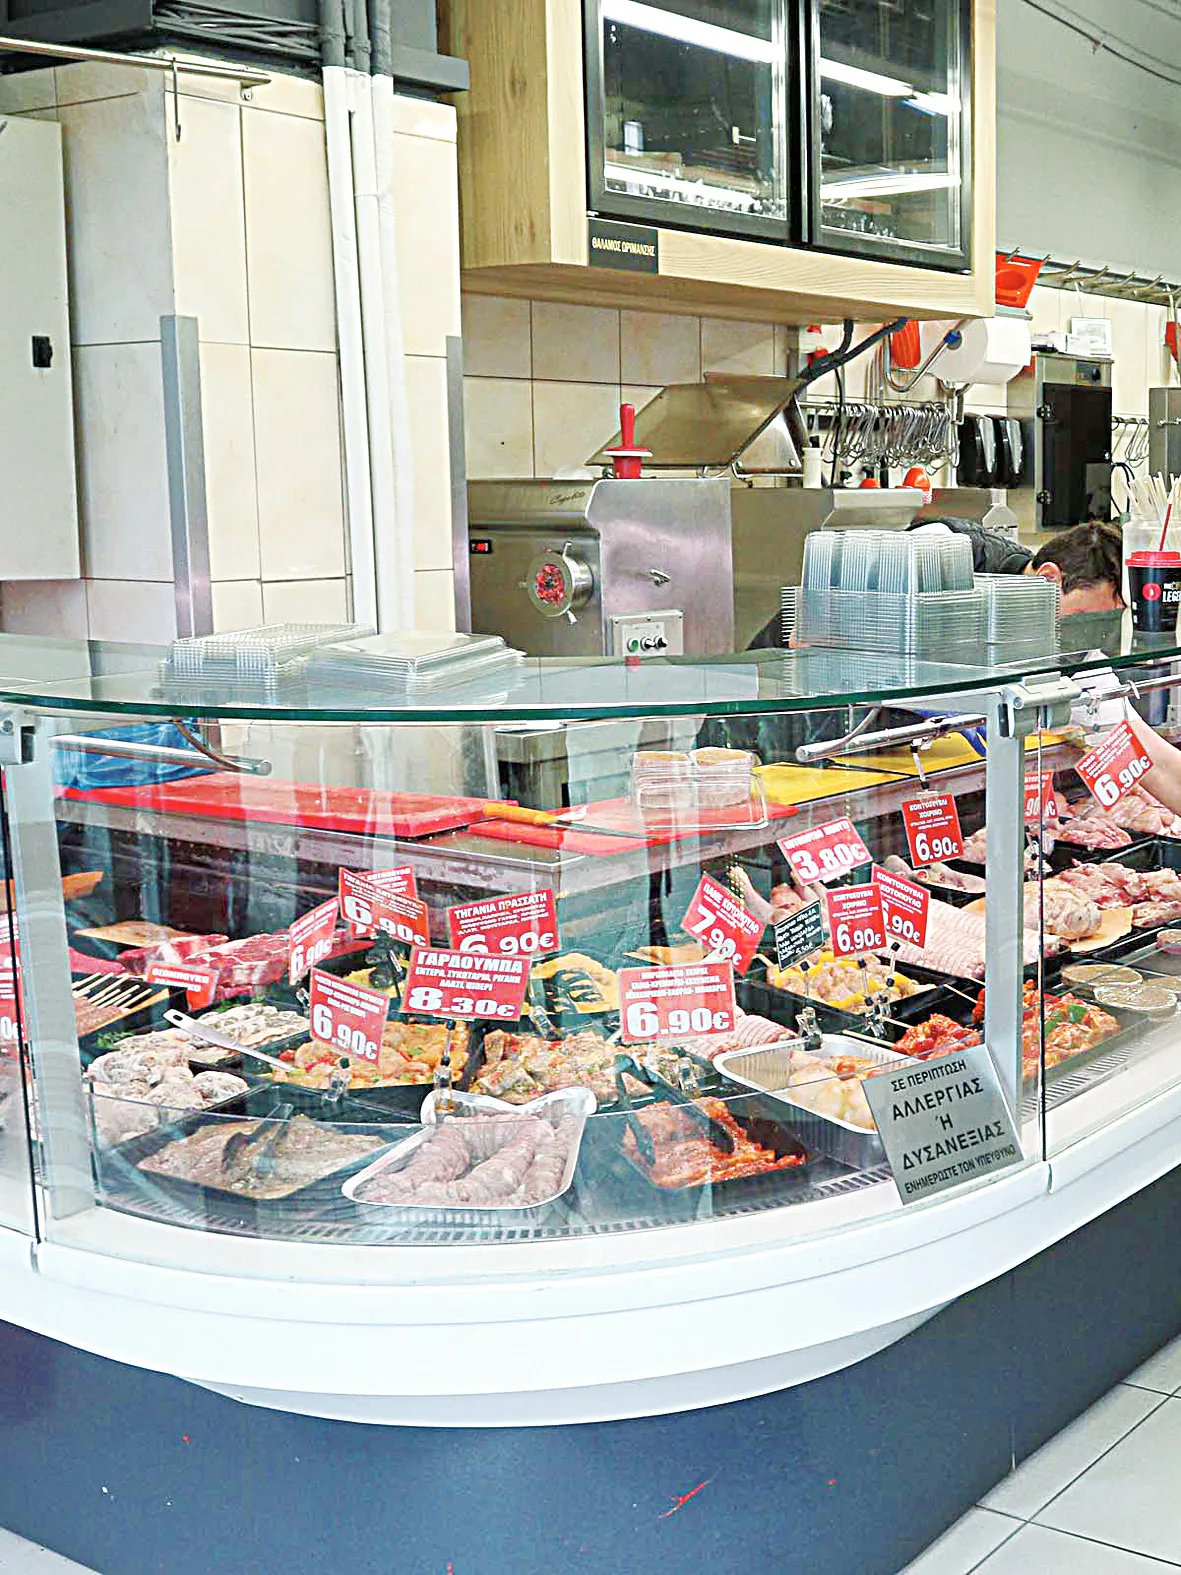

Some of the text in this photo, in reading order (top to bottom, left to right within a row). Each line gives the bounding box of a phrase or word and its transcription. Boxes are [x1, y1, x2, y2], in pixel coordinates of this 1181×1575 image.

[591, 237, 621, 252] ΘΑΛΑΜΟΣ
[1093, 755, 1150, 807] 6.90€
[791, 843, 866, 880] 3.80€
[915, 832, 959, 862] 6.90€
[344, 895, 427, 947] 6.90€
[453, 903, 497, 920] ΤΗΓΑΝΙΑ
[836, 923, 882, 953] 6.90€
[290, 938, 331, 981] 6.90€
[416, 951, 523, 974] ΓΑΡΔΟΥΜΠΑ
[408, 986, 516, 1017] 8.30€
[626, 1001, 730, 1038] 6.90€
[313, 1003, 378, 1060] 6.90€
[891, 1059, 967, 1093] ΣΕ ΠΕΡΙΠΤΩΣΗ
[892, 1077, 984, 1121] ΑΛΛΕΡΓΙΑΣ
[902, 1121, 1005, 1171] ΔΥΣΑΝΕΞΙΑΣ
[904, 1144, 1016, 1194] ΕΝΗΜΕΡΩΣΤΕ ΤΟΝ ΥΠΕΥΘΥΝΟ
